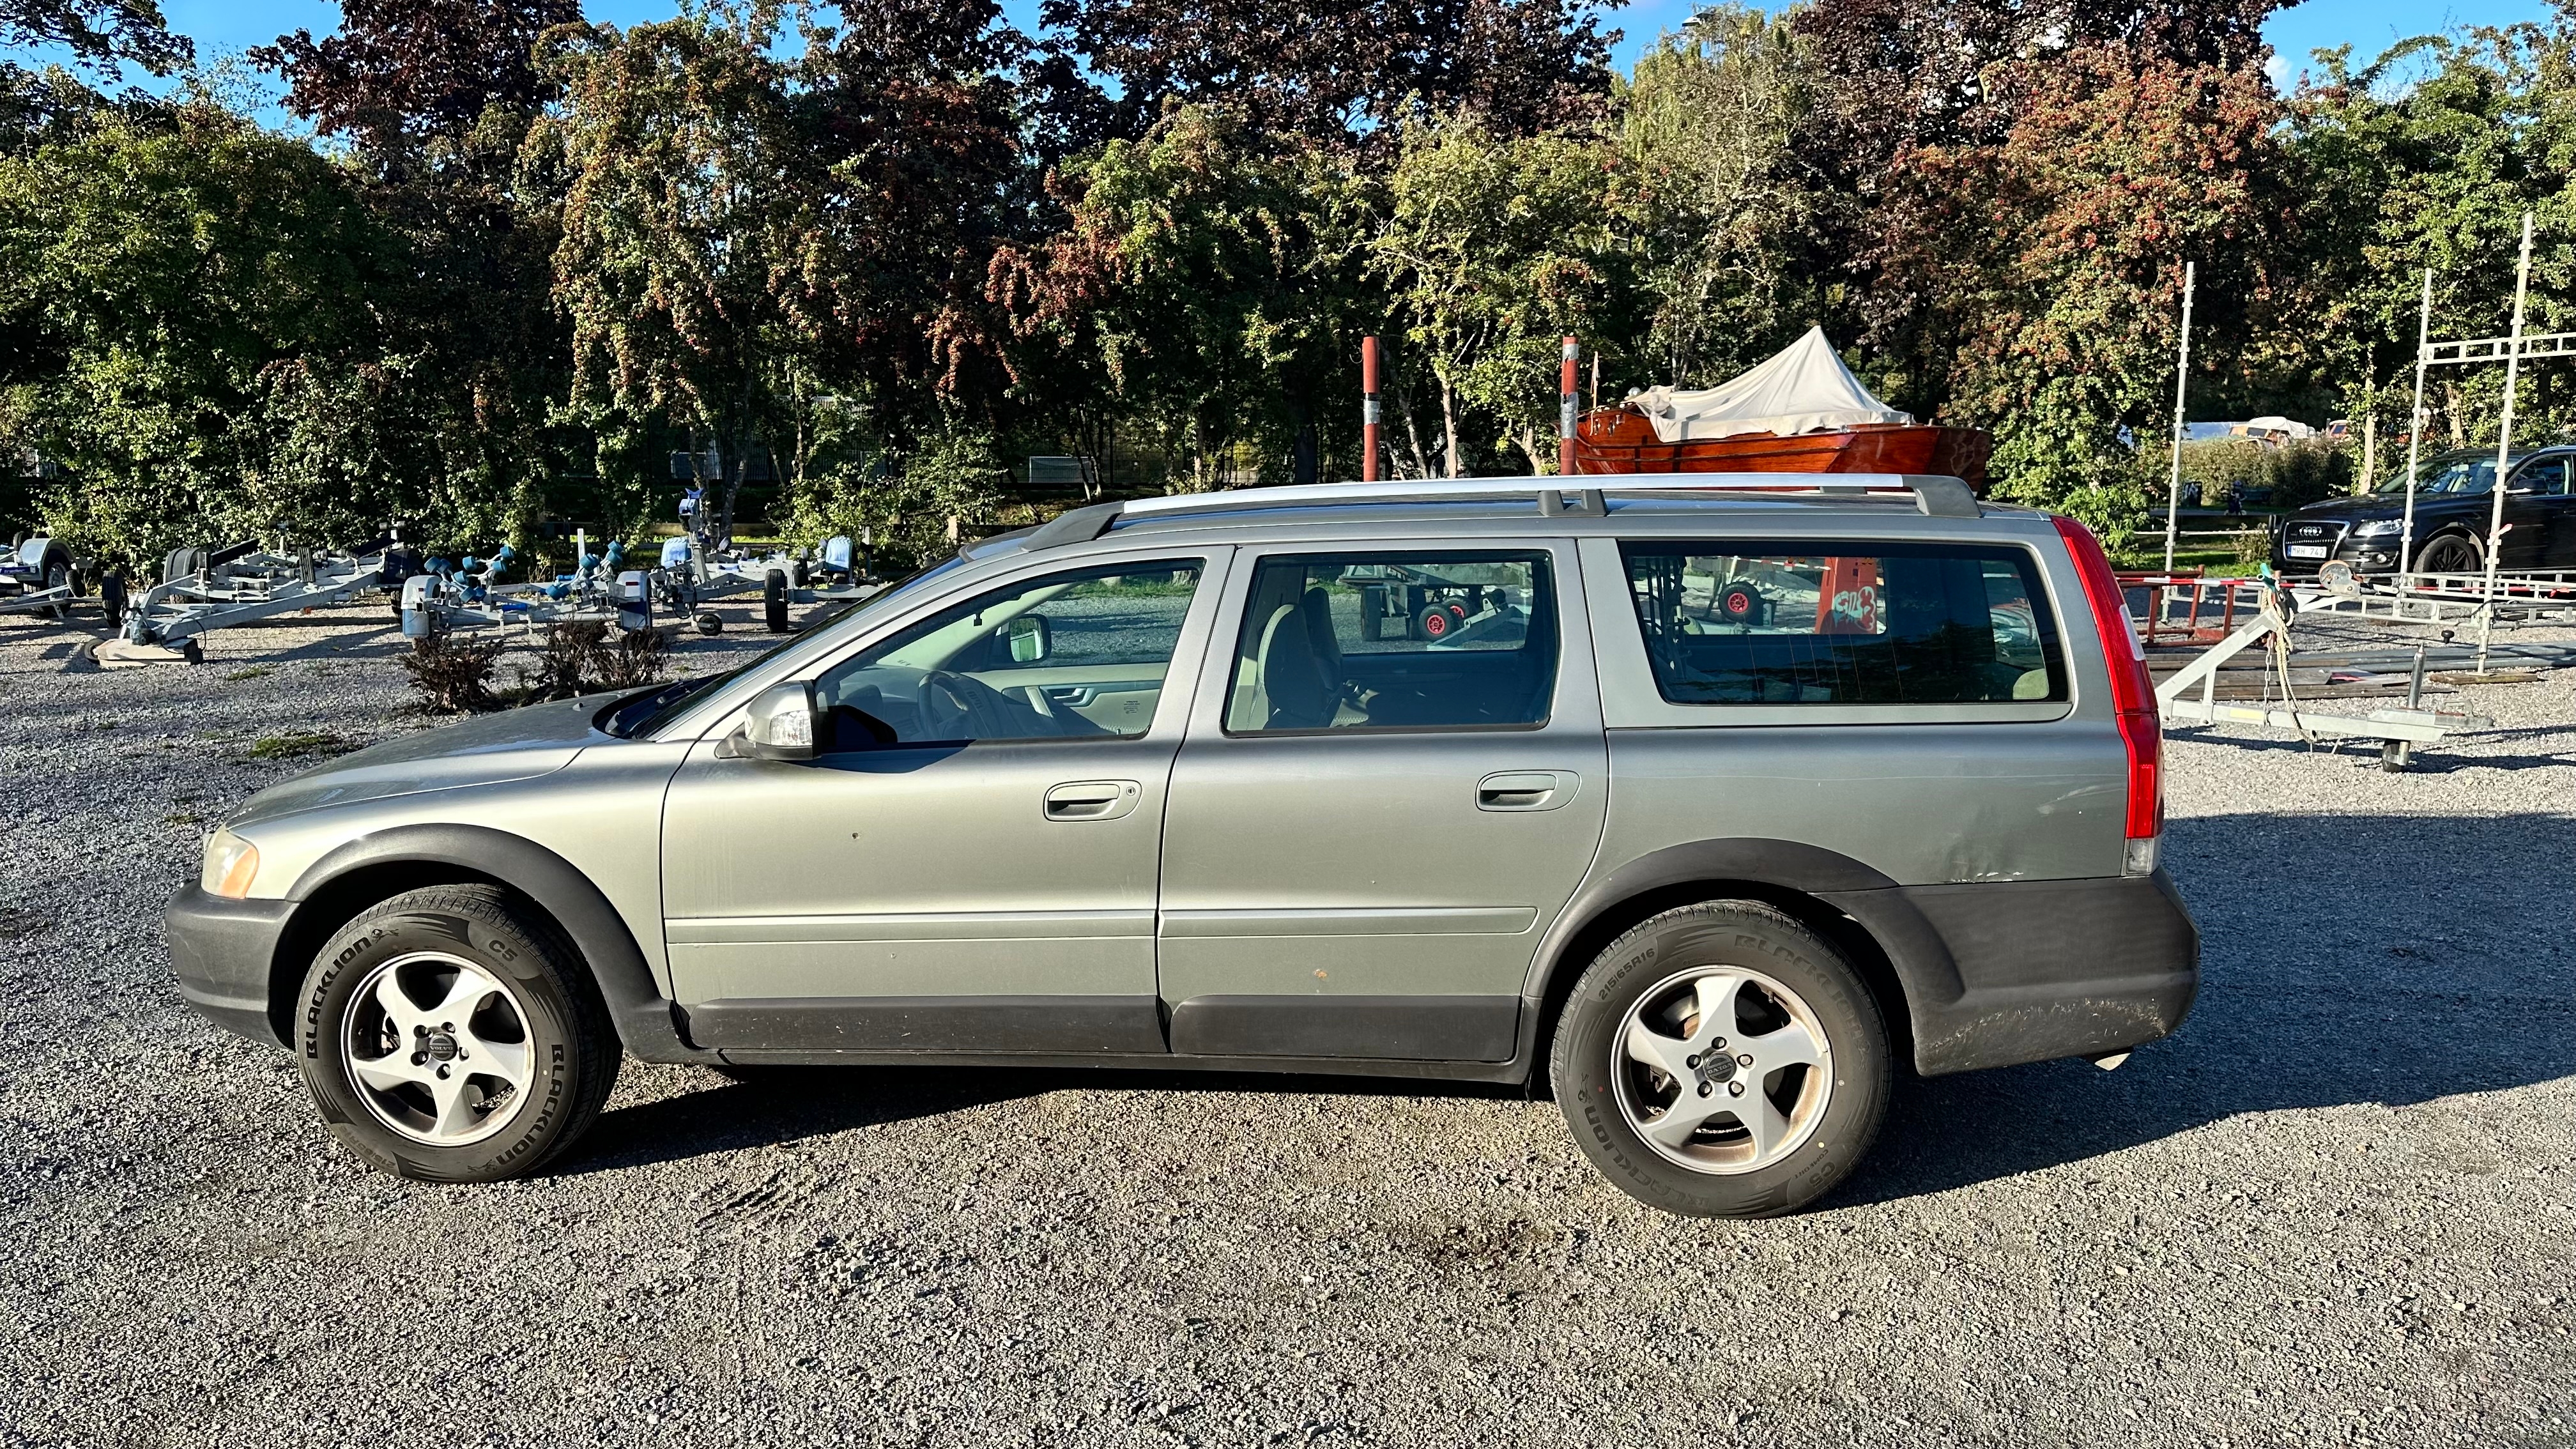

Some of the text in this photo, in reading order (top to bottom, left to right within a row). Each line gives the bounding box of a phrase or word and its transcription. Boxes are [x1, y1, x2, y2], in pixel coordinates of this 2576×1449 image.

[2310, 548, 2324, 556] 742
[479, 949, 514, 975] COMFORT
[489, 940, 518, 962] C5
[1598, 948, 1655, 1000] 215/65R16
[306, 937, 372, 1059] BLACKLION
[1708, 1063, 1733, 1074] VOLVO
[496, 1045, 564, 1165] BLACKLION
[1795, 1149, 1828, 1179] COMFORT
[1809, 1162, 1836, 1188] C5
